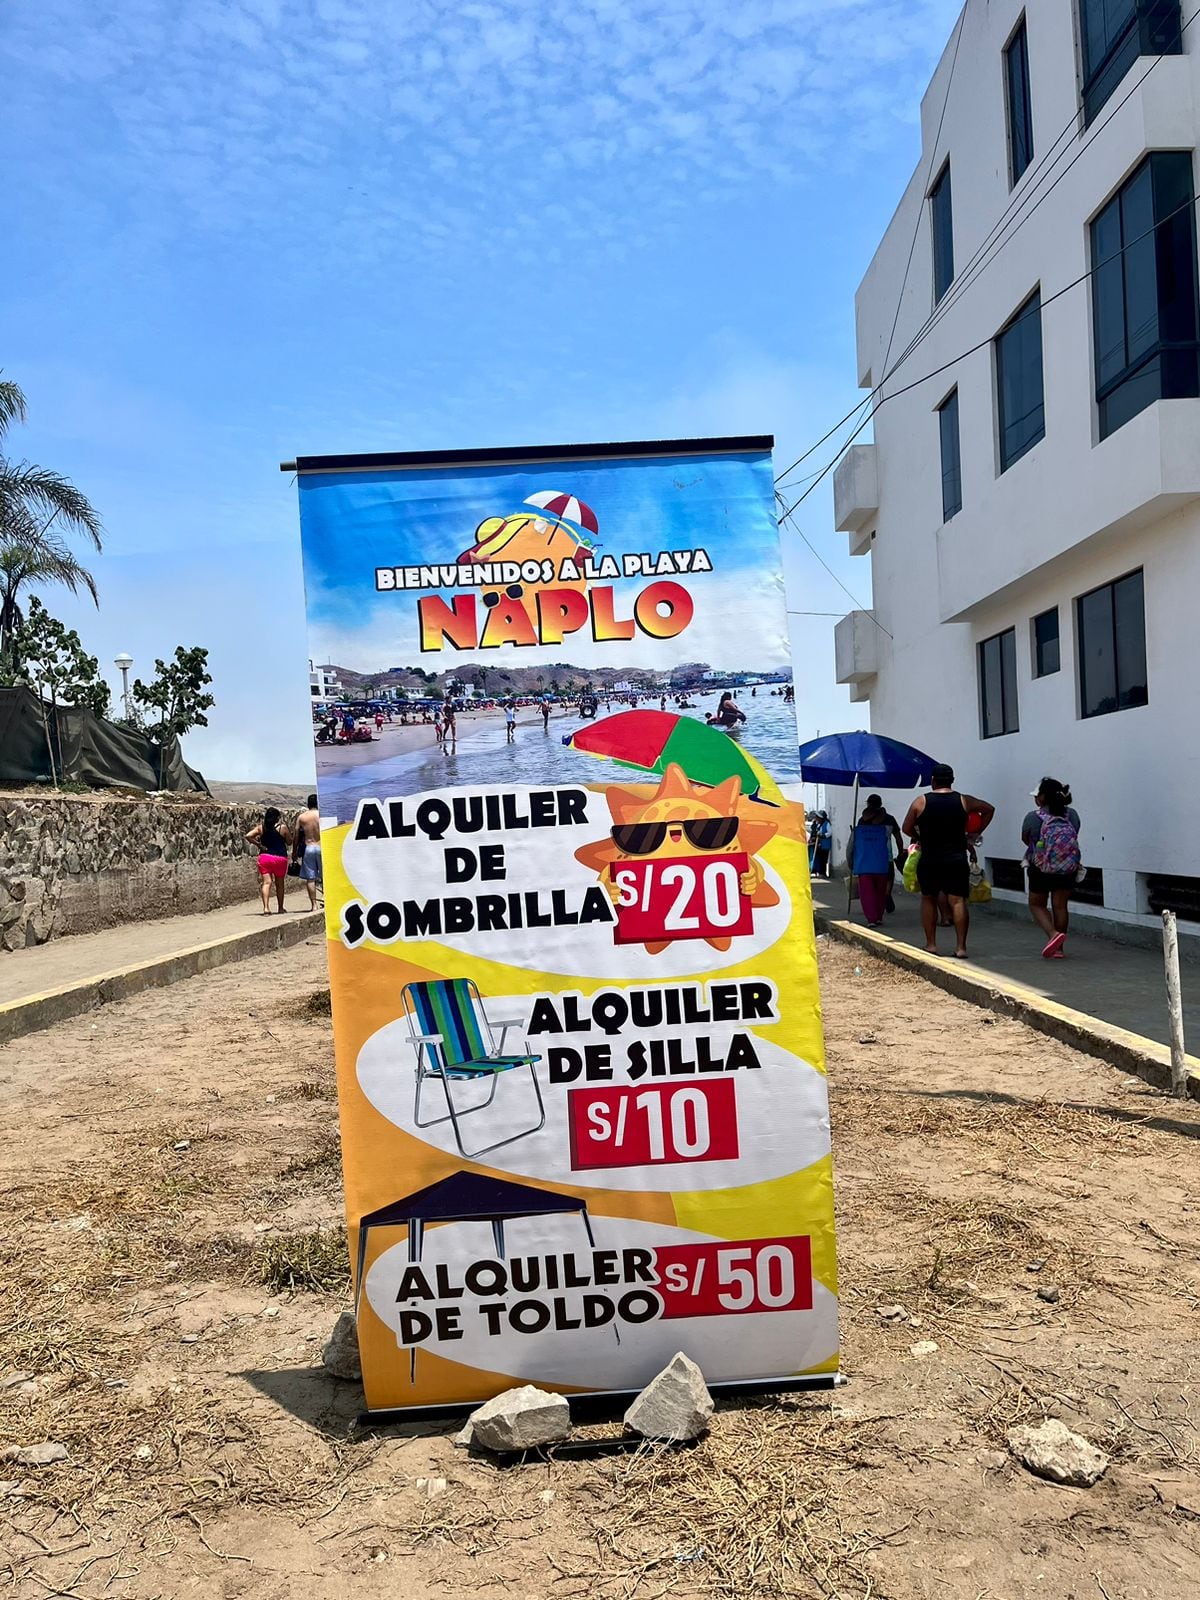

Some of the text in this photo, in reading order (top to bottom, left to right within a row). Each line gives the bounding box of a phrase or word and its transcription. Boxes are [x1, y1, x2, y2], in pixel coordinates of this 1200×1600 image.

[376, 548, 713, 590] BIENVENIDOS A LA PLAYA
[355, 789, 589, 840] ALQUILER
[444, 844, 507, 883] DE
[343, 886, 614, 944] SOMBRILLA
[527, 982, 775, 1036] ALQUILER
[548, 1033, 761, 1084] DE SILLA
[396, 1248, 657, 1303] ALQUILER
[399, 1290, 660, 1345] DE TOLDO
